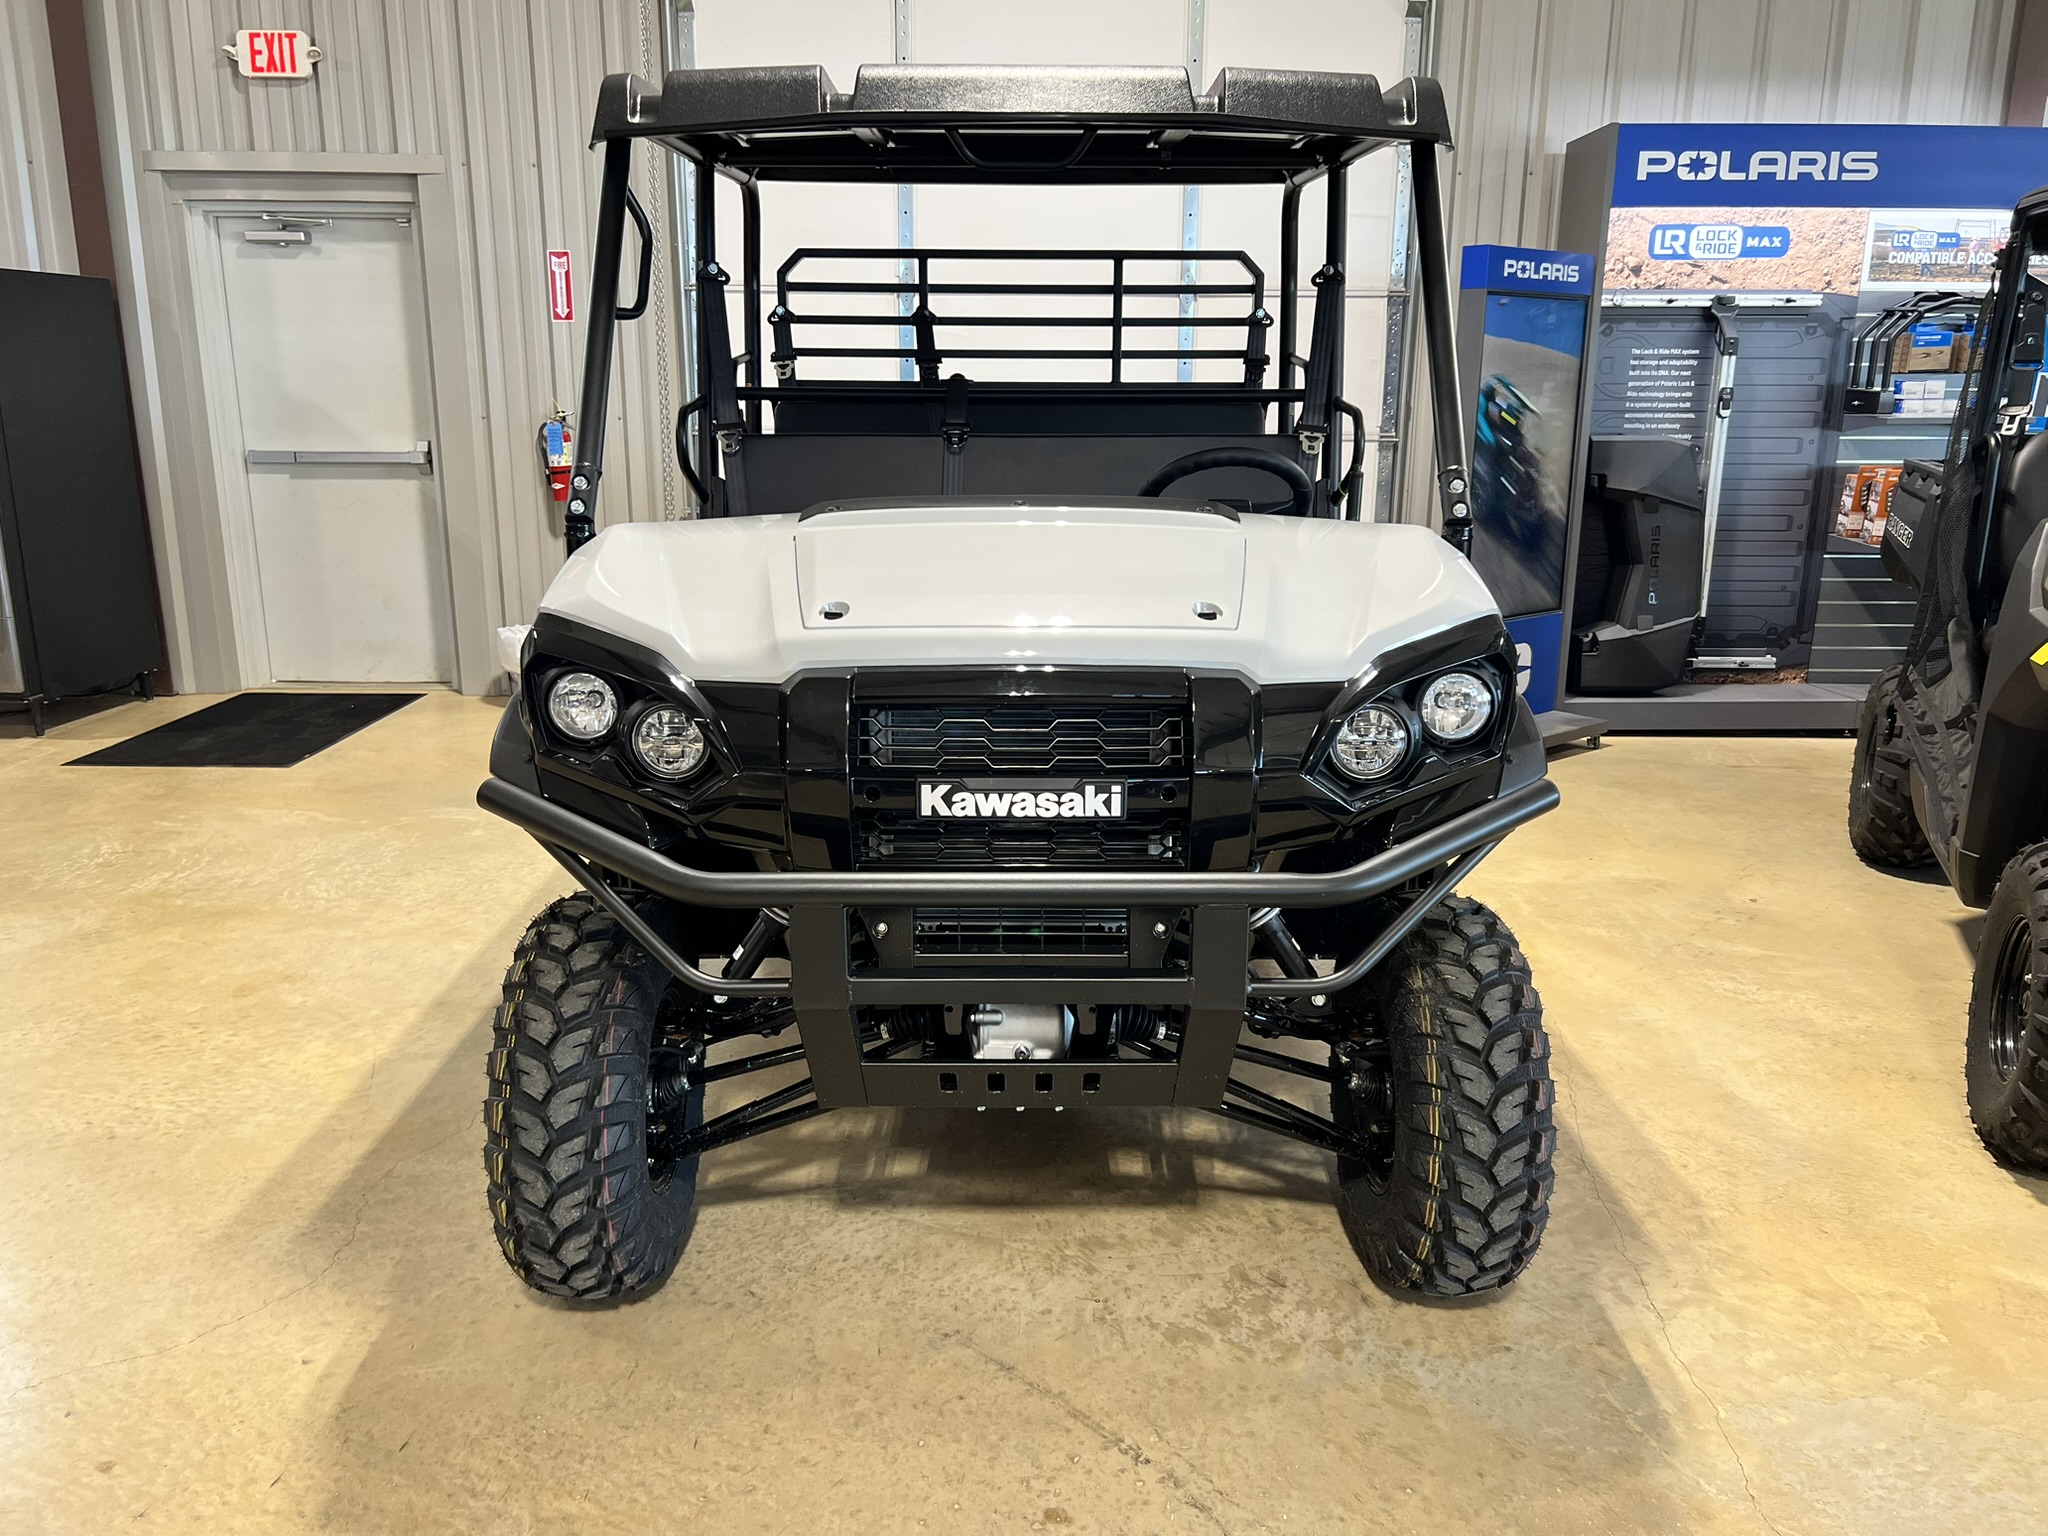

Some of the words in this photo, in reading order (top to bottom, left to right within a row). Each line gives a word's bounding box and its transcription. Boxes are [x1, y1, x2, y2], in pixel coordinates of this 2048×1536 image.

[248, 32, 297, 73] EXIT
[1636, 150, 1879, 181] POLARIS
[1696, 230, 1738, 241] LOCK
[1746, 236, 1783, 248] MAX
[1695, 243, 1737, 254] &RIDE
[1888, 251, 1966, 265] COMPATIBLE
[1503, 259, 1580, 283] POLARIS
[920, 783, 1123, 817] Kawasaki
